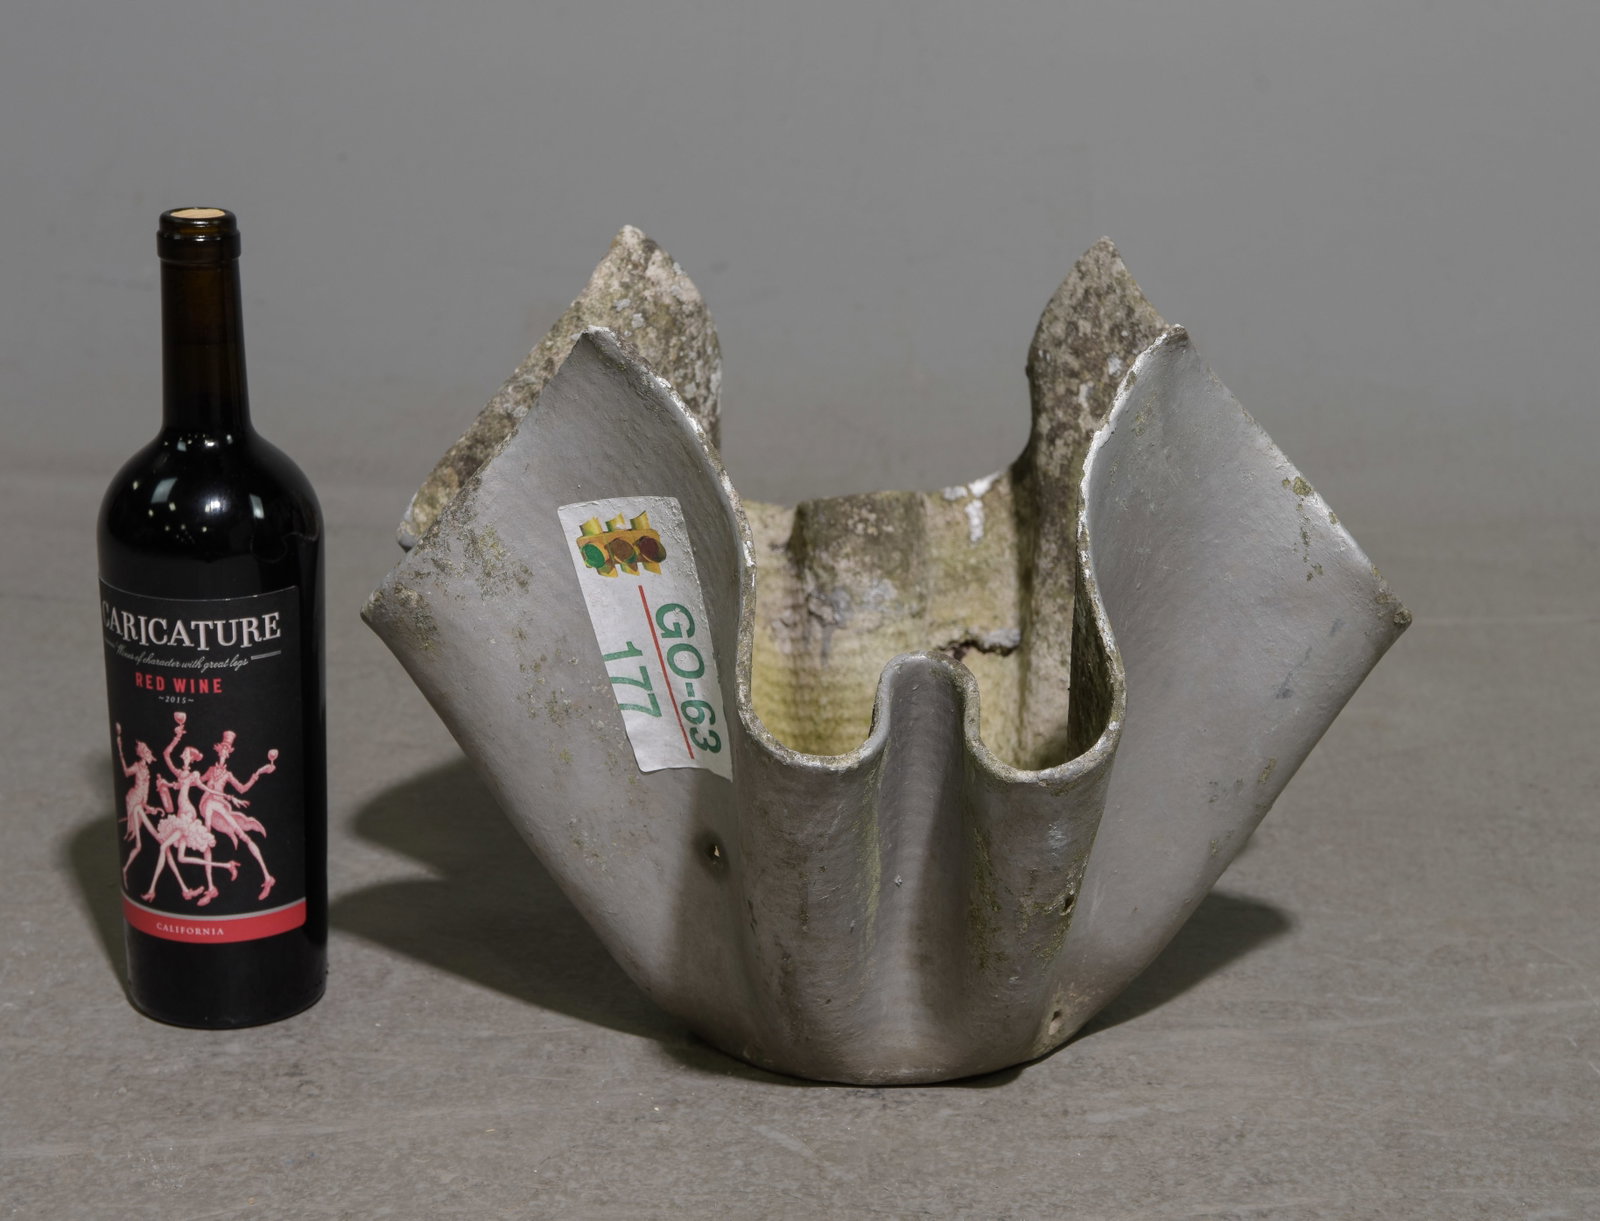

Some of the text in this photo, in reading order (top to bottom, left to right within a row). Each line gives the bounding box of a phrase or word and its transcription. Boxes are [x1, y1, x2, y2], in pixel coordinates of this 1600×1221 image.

[102, 600, 281, 651] CARICATURE
[142, 652, 181, 668] character
[181, 656, 205, 669] with
[200, 658, 230, 673] great
[229, 654, 249, 671] legs
[603, 641, 662, 718] 177
[655, 603, 721, 754] GO-63
[135, 671, 223, 694] RED WINE
[156, 922, 225, 936] CALIFORNIA
